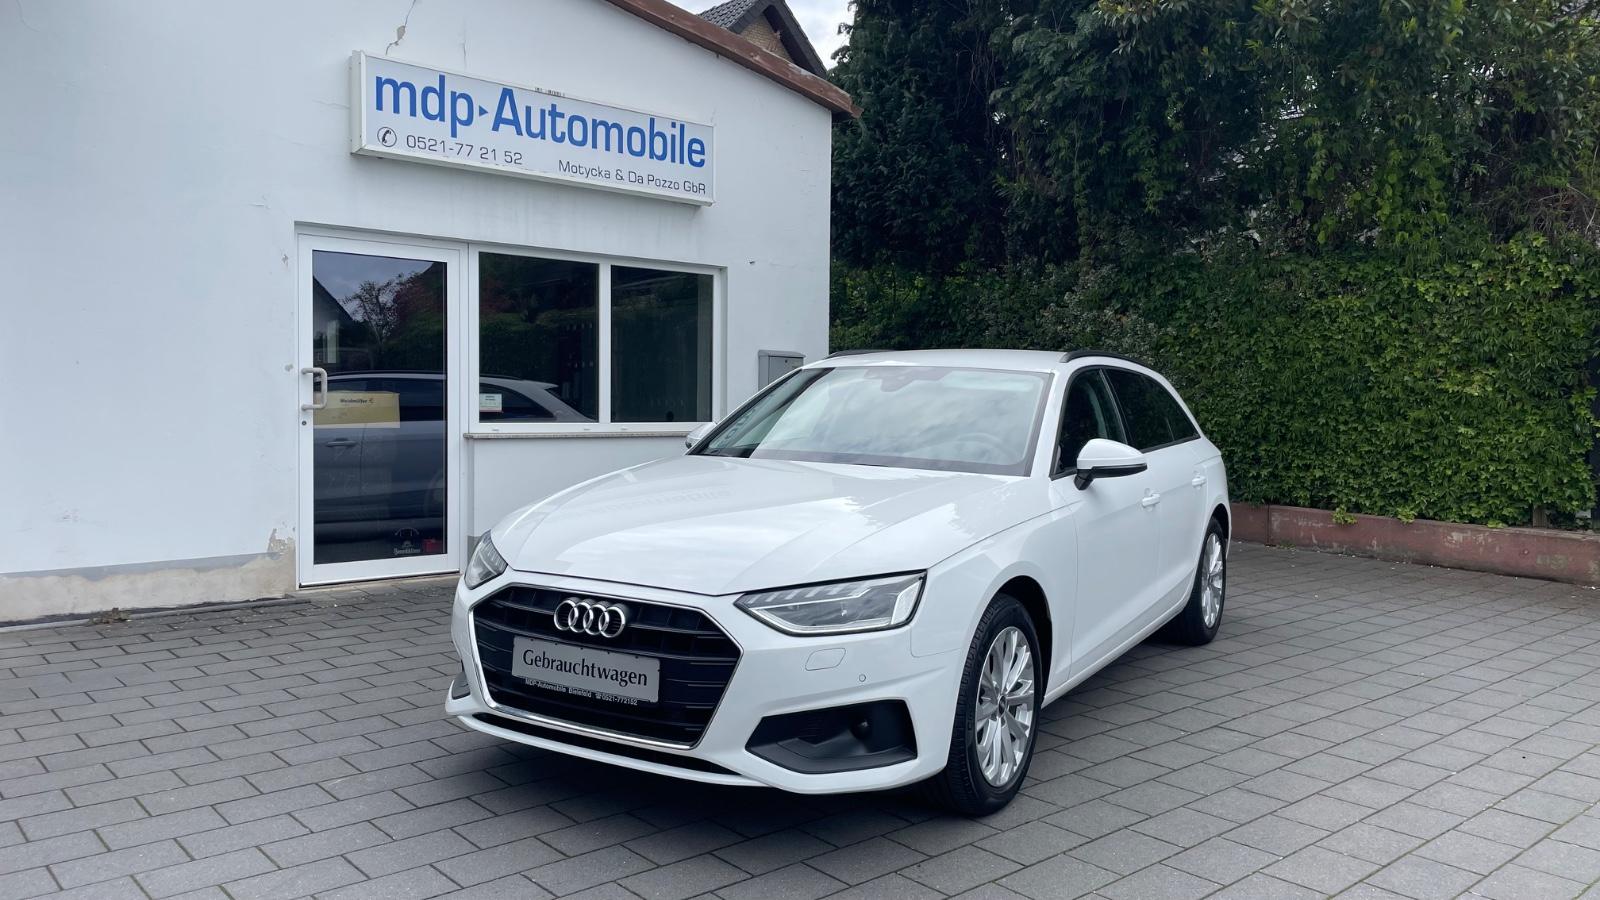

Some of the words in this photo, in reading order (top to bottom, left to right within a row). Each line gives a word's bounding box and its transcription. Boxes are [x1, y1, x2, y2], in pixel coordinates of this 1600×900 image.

[375, 74, 474, 138] mdp
[491, 87, 706, 168] Automobile
[406, 134, 474, 157] 0521-77
[479, 146, 497, 161] 21
[504, 150, 523, 165] 52
[558, 159, 611, 179] Motycka
[615, 168, 625, 181] &
[628, 171, 644, 185] Da
[647, 174, 680, 191] Pozzo
[683, 180, 706, 195] GbR
[522, 649, 648, 688] Gebrauchtwagen
